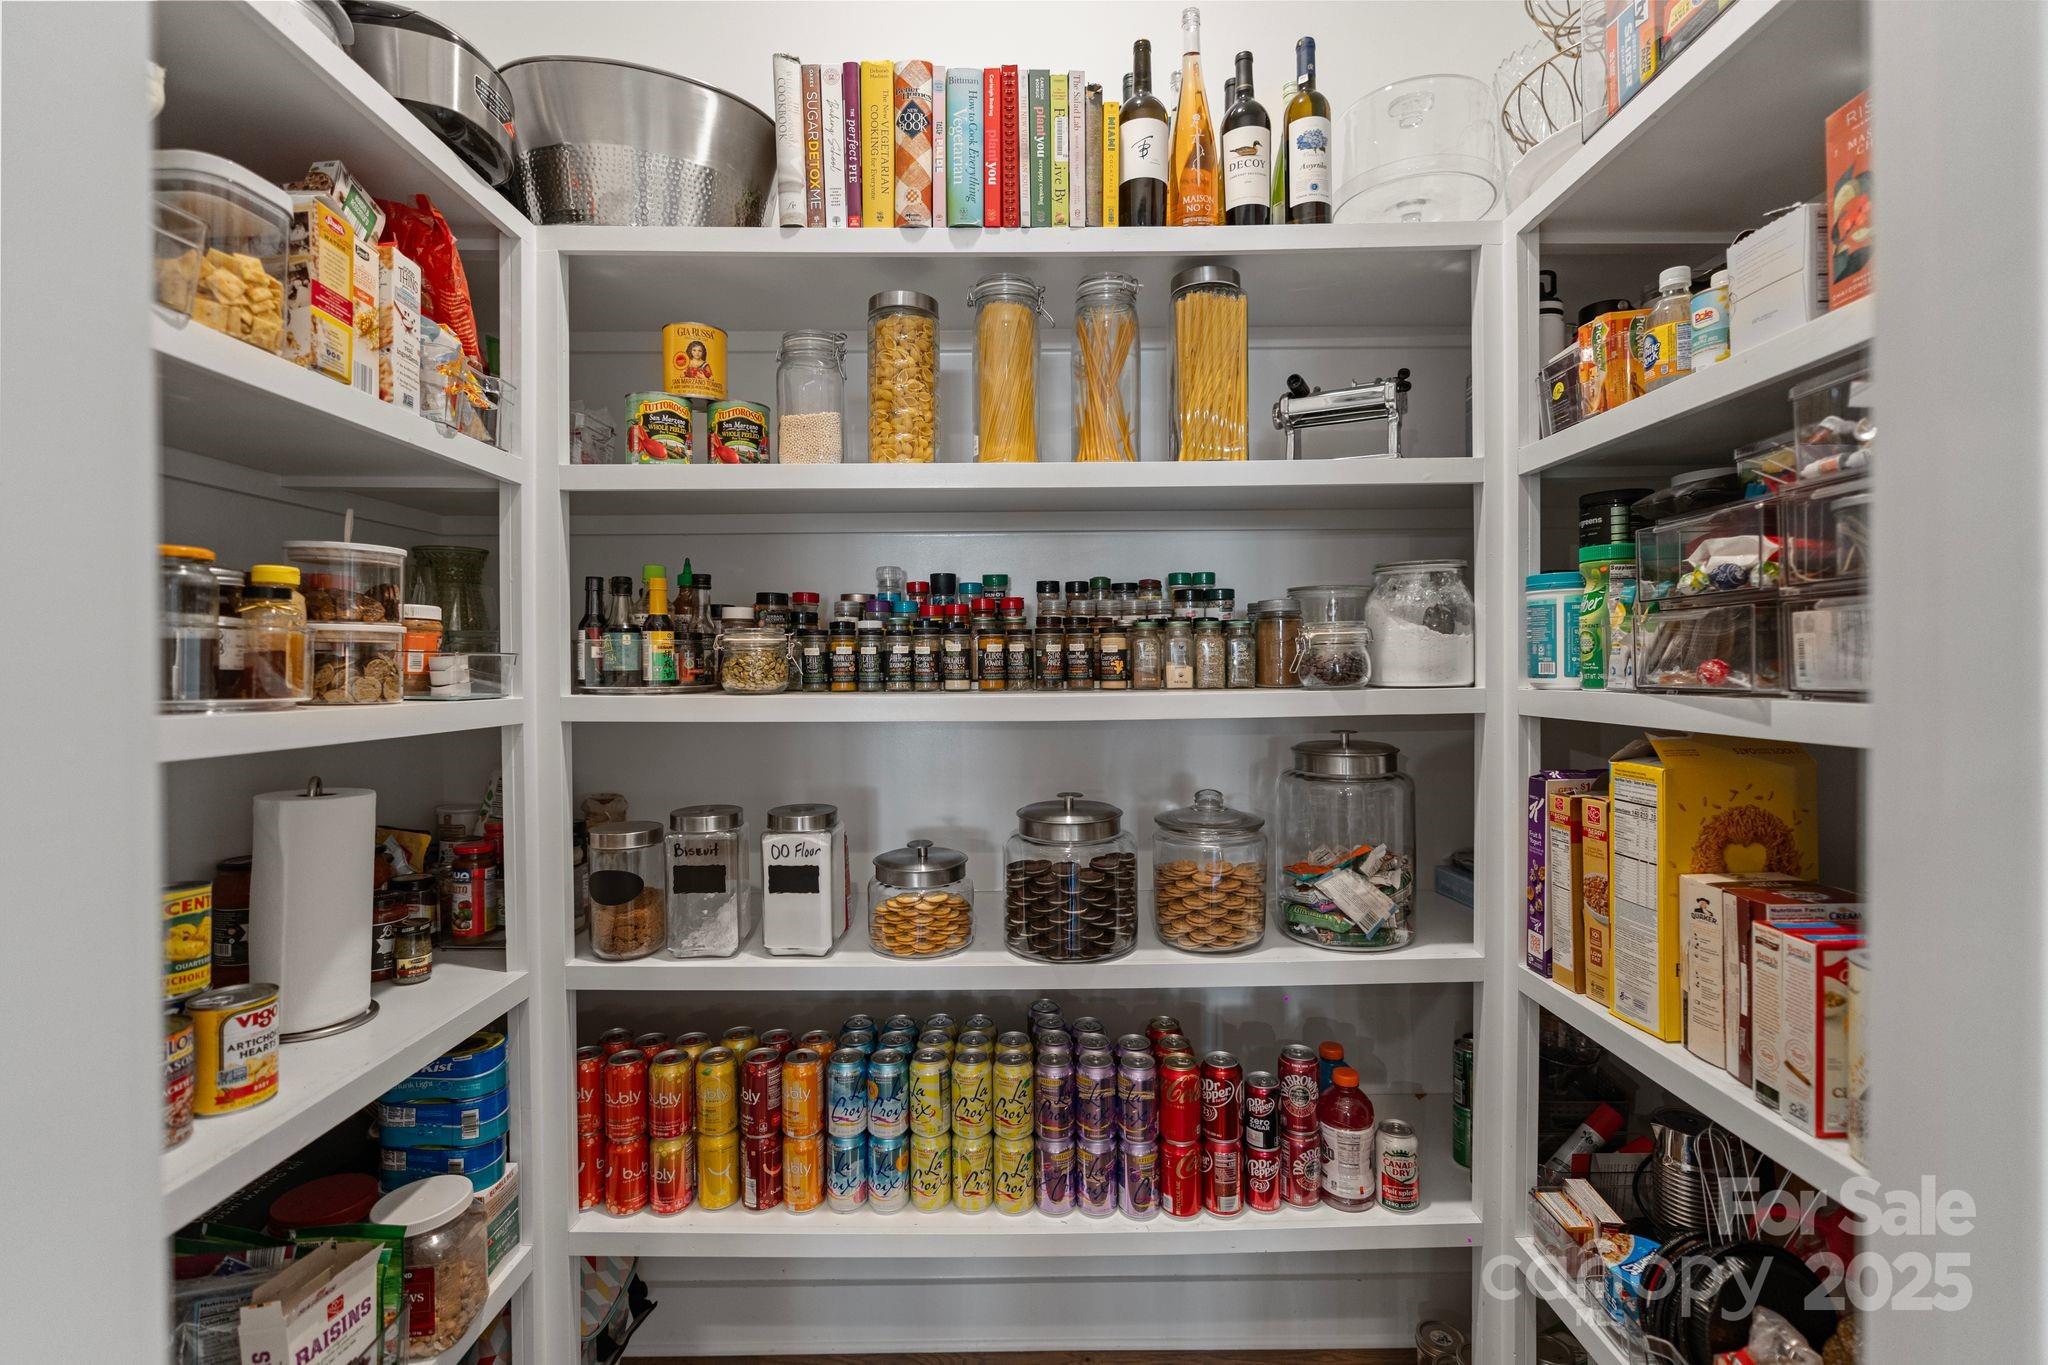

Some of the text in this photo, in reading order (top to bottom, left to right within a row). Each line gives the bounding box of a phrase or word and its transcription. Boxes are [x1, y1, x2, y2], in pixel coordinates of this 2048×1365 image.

[948, 76, 979, 86] Bittman
[1073, 75, 1081, 91] The
[968, 90, 978, 108] How
[776, 77, 788, 141] COOKBOOK
[897, 112, 927, 124] COOK
[870, 105, 879, 155] COOKING
[898, 121, 928, 132] BOOK
[969, 122, 978, 145] Cook
[1107, 116, 1116, 152] MIAMI
[847, 119, 859, 164] perfect
[949, 108, 967, 185] Vegetarian
[880, 121, 890, 195] VEGETARIAN
[1229, 159, 1266, 173] DECOY
[849, 164, 858, 183] PIE
[966, 147, 978, 204] Everything
[1183, 194, 1215, 205] MAISON
[398, 266, 418, 294] THINS
[1695, 309, 1714, 323] Dole
[677, 327, 715, 339] GIA RUSSA
[643, 401, 690, 417] TUTTOROSSO
[717, 407, 763, 422] TUTTOROSSO
[648, 422, 687, 434] WHOLE PEELED
[661, 415, 686, 425] Marzano
[734, 422, 759, 432] Marzano
[741, 431, 760, 439] PEELED
[984, 652, 1004, 660] CURRY
[984, 659, 1004, 667] POWDER
[1529, 798, 1544, 823] K
[1588, 828, 1605, 838] BERRY
[1529, 837, 1542, 847] Yogurt
[165, 894, 211, 917] CENT
[1691, 913, 1718, 925] QUAKER
[408, 967, 428, 975] PESTO
[227, 1030, 278, 1052] ARTICHO
[239, 1039, 278, 1059] HEARTS
[421, 1062, 453, 1073] Kist
[415, 1080, 433, 1089] Light
[886, 1073, 904, 1102] La
[970, 1078, 989, 1103] La
[1009, 1080, 1028, 1105] La
[1206, 1078, 1221, 1092] Dr
[604, 1088, 641, 1105] bubly
[741, 1087, 760, 1105] bly
[1203, 1086, 1232, 1103] epper
[871, 1097, 908, 1122] Croix
[910, 1103, 932, 1119] oix
[955, 1096, 992, 1122] Croix
[995, 1097, 1032, 1123] Croix
[1248, 1101, 1274, 1114] Pepper
[1249, 1116, 1270, 1127] zero
[1249, 1123, 1270, 1131] SUGAR
[623, 1161, 648, 1180] bub
[834, 1152, 852, 1178] La
[876, 1153, 895, 1179] La
[925, 1151, 943, 1176] La
[1010, 1153, 1029, 1178] La
[1248, 1163, 1279, 1179] Pepper
[653, 1168, 676, 1184] bly
[1392, 1169, 1411, 1177] DRY
[912, 1168, 949, 1195] Croix
[996, 1171, 1033, 1198] Croix
[1254, 1181, 1263, 1190] 23
[1385, 1199, 1400, 1208] ZERO
[294, 1297, 372, 1365] RAISINS
